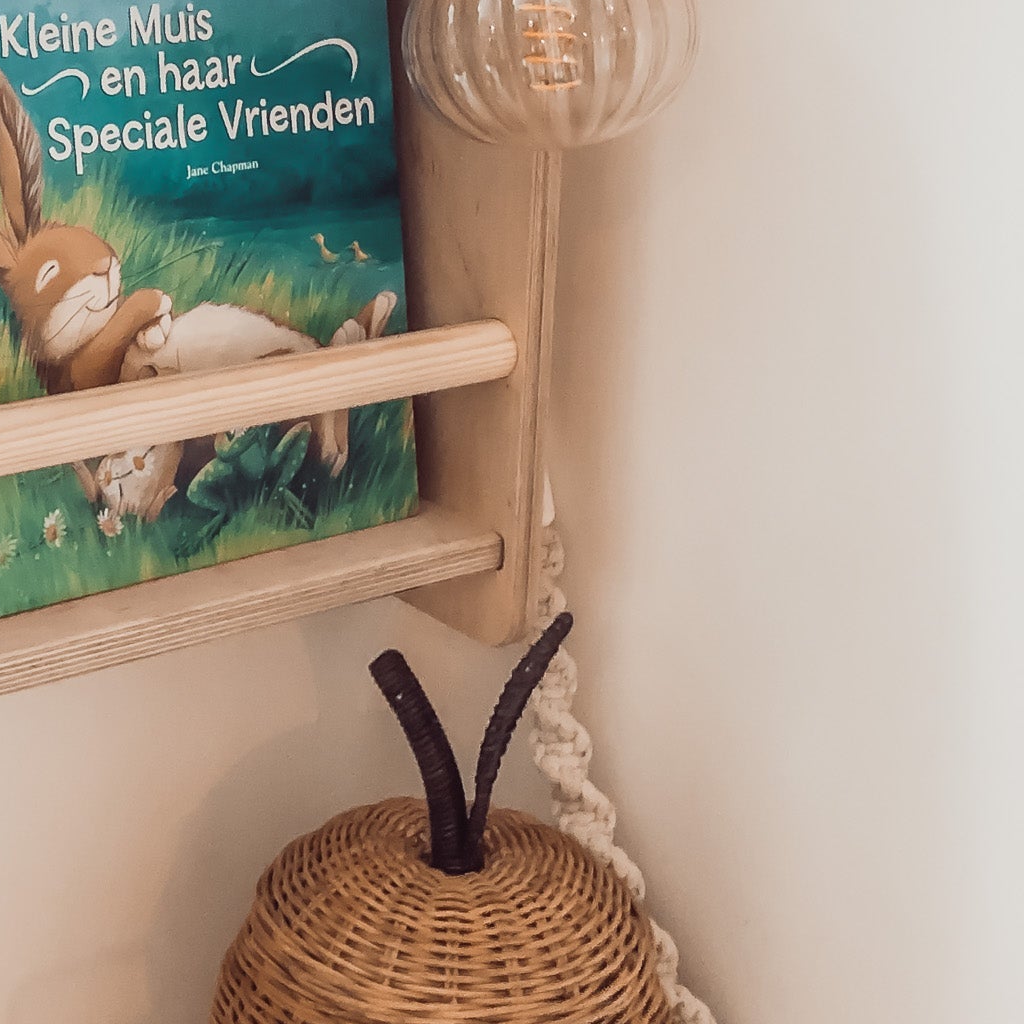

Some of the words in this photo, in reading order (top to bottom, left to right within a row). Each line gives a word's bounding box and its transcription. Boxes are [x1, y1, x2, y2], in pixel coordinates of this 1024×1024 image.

[129, 3, 214, 47] Muis
[100, 64, 146, 98] en
[158, 50, 242, 94] haar
[48, 103, 208, 176] Speciale
[218, 90, 375, 141] Vrienden
[186, 164, 209, 180] Jane
[211, 160, 259, 174] Chapman
